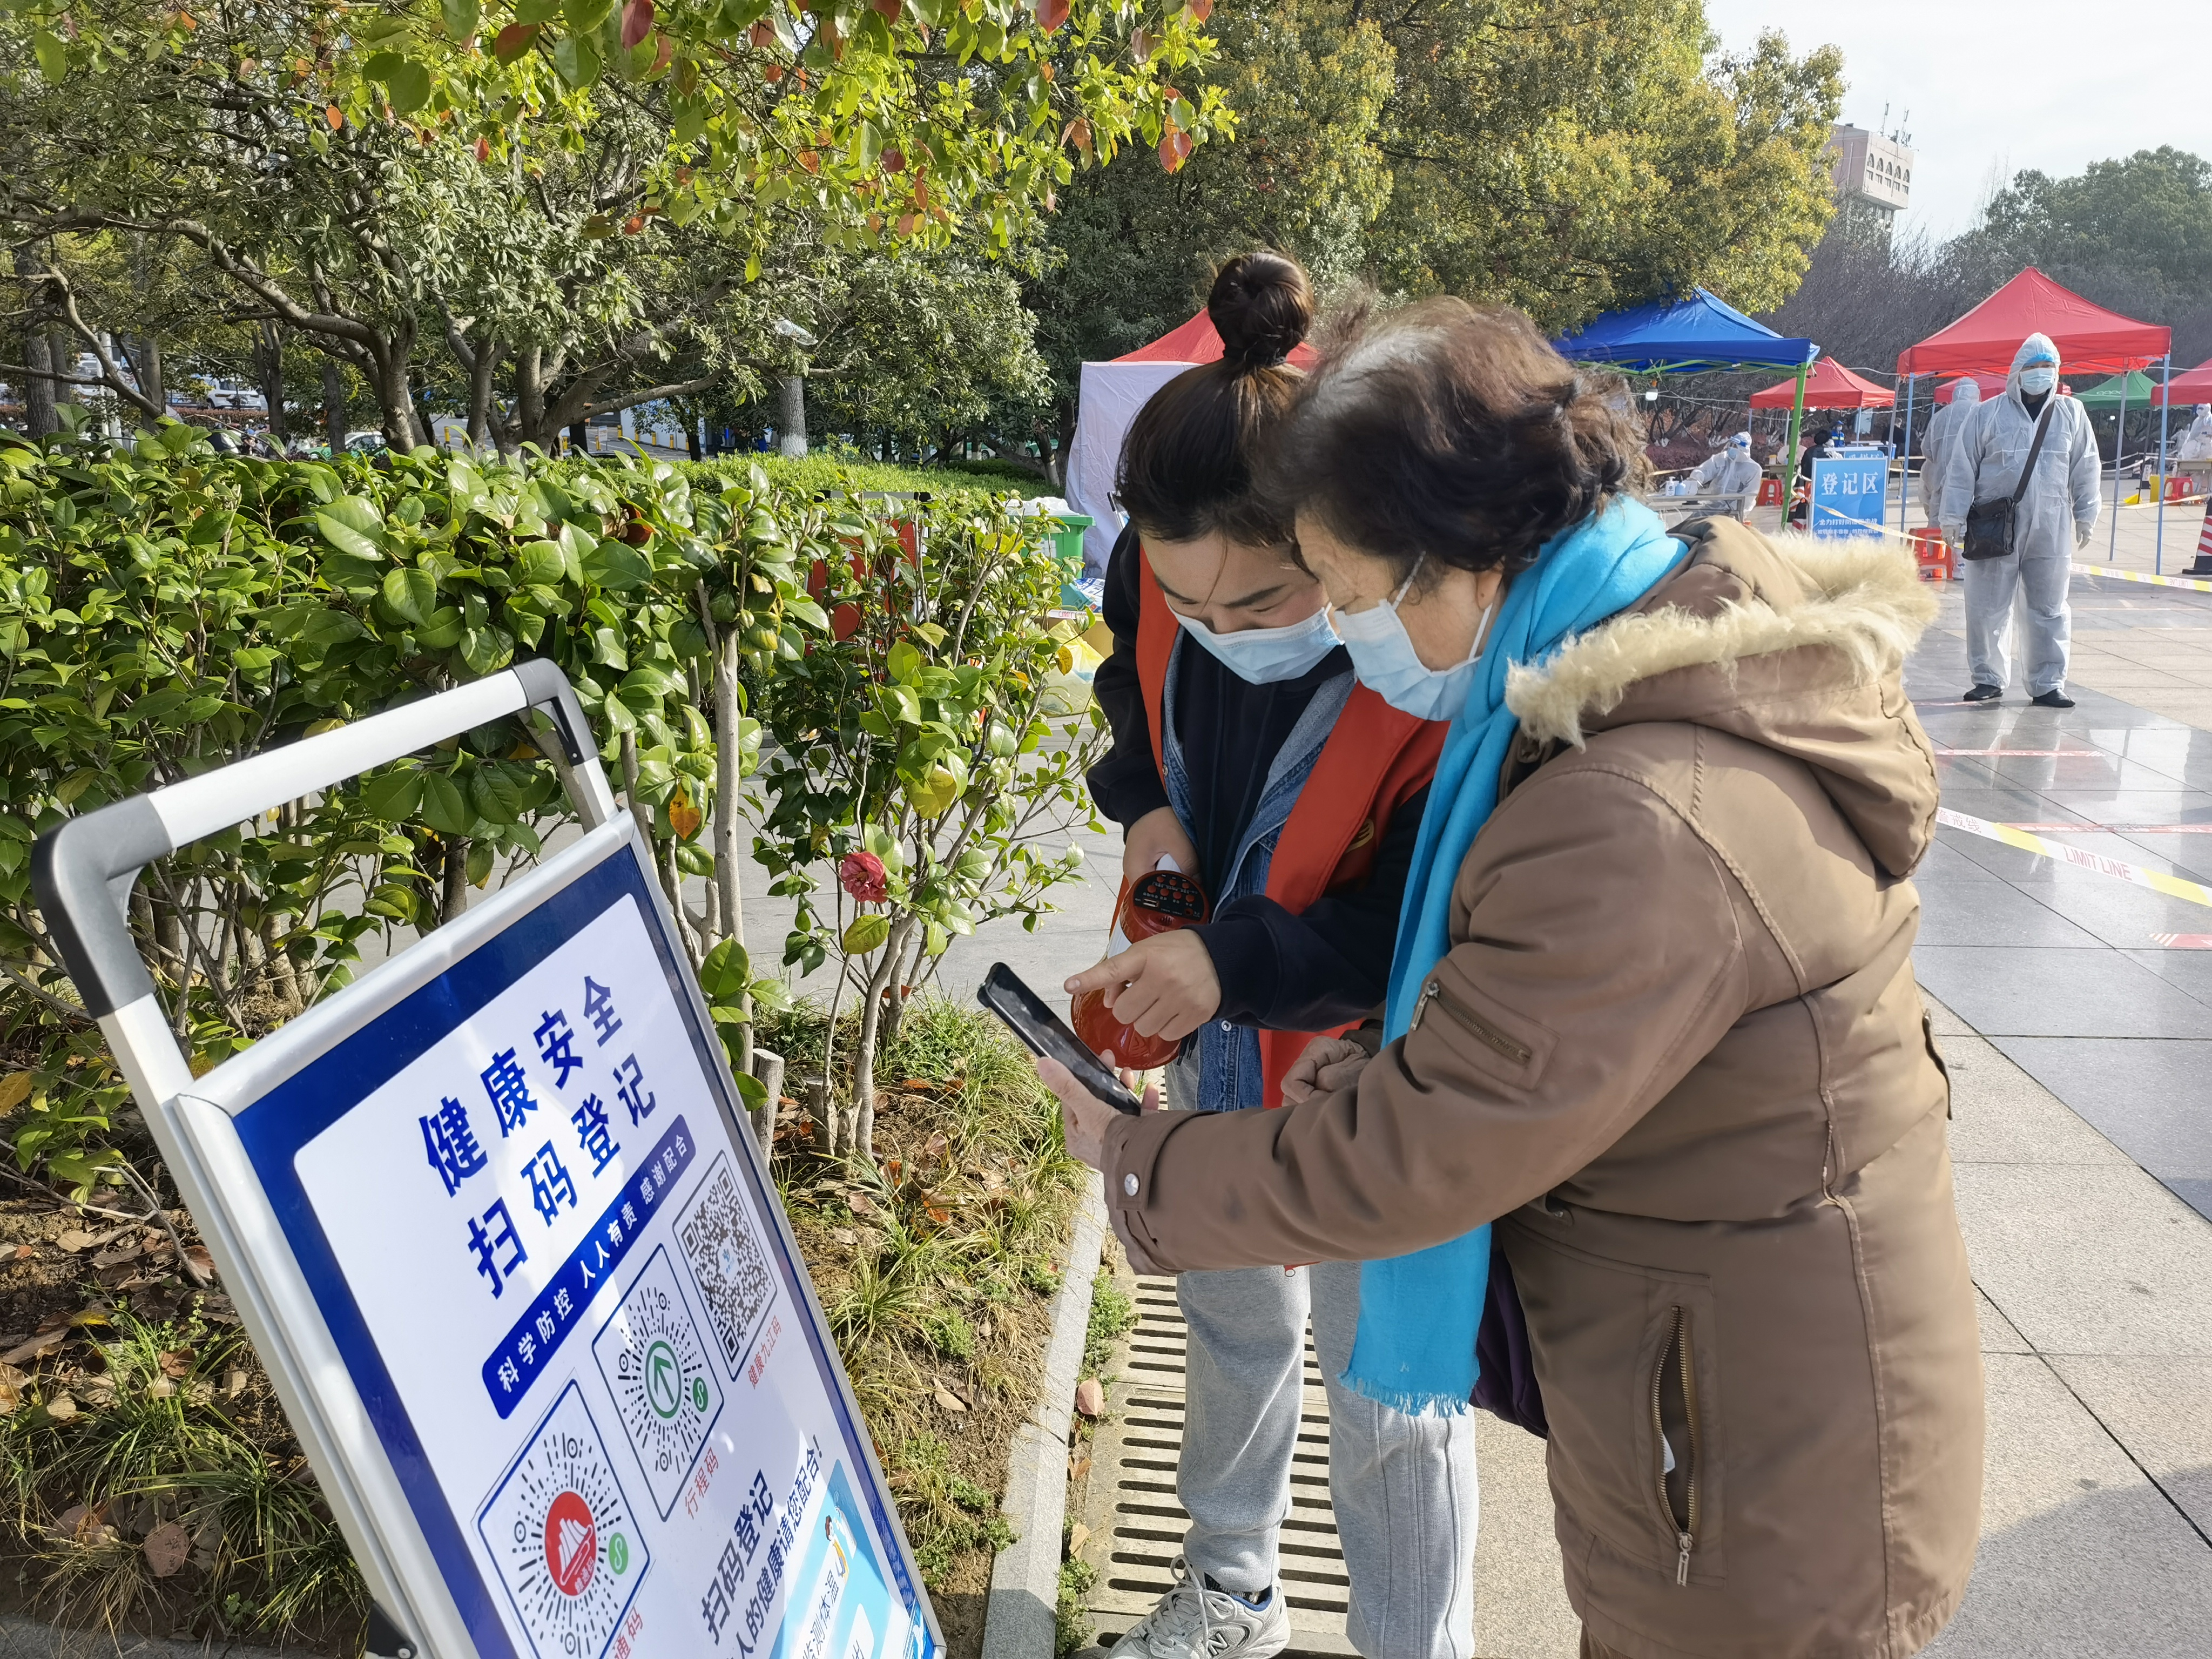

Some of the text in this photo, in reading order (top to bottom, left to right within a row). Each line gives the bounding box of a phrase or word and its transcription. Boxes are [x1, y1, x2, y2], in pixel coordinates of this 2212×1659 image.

[1821, 471, 1879, 496] 登记区
[2063, 846, 2132, 881] LIMIT LINE
[419, 975, 623, 1198] 健康安全
[467, 1053, 656, 1300] 扫码登记
[497, 1134, 687, 1393] 科学防控 人人有责 感谢配合
[748, 1314, 781, 1390] 健康九江码
[685, 1446, 719, 1520] 行程码
[702, 1469, 773, 1646] 扫码登记
[726, 1434, 824, 1659] 人的健康请您配合!
